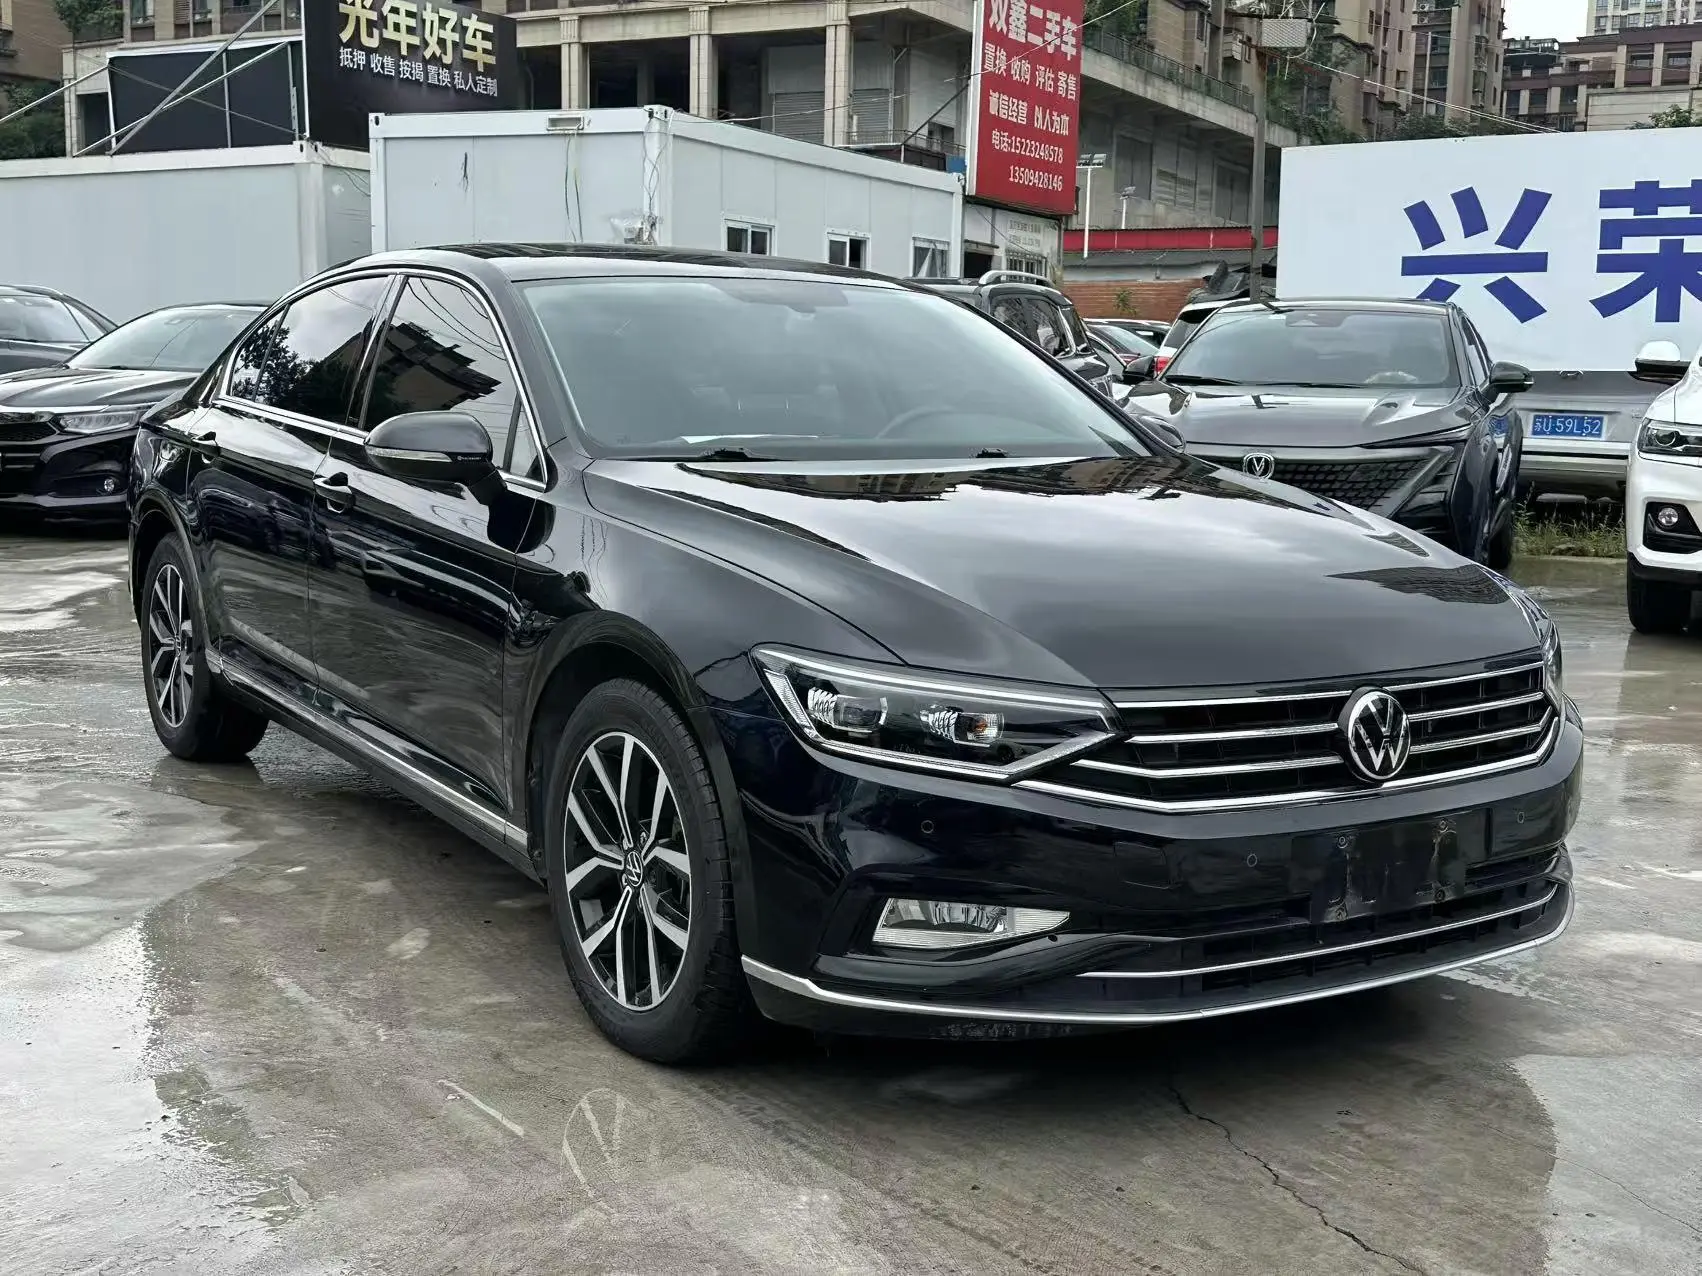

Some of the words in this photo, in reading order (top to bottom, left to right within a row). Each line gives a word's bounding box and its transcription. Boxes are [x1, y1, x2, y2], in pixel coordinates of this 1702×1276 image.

[338, 0, 497, 73] 光年好车
[988, 0, 1077, 61] 双鑫二手车
[339, 46, 366, 71] 抵押
[370, 53, 396, 77] 收售
[399, 59, 424, 83] 按揭
[427, 64, 451, 88] 置换
[453, 71, 498, 97] 私人定制
[984, 42, 1007, 77] 置换
[1010, 56, 1031, 85] 收购
[1035, 64, 1055, 93] 评估
[1057, 70, 1077, 100] 寄售
[988, 89, 1028, 125] 诚信经营
[1034, 104, 1070, 136] 以人为本
[1008, 165, 1063, 192] 13509428146
[1400, 180, 1702, 324] 兴荣
